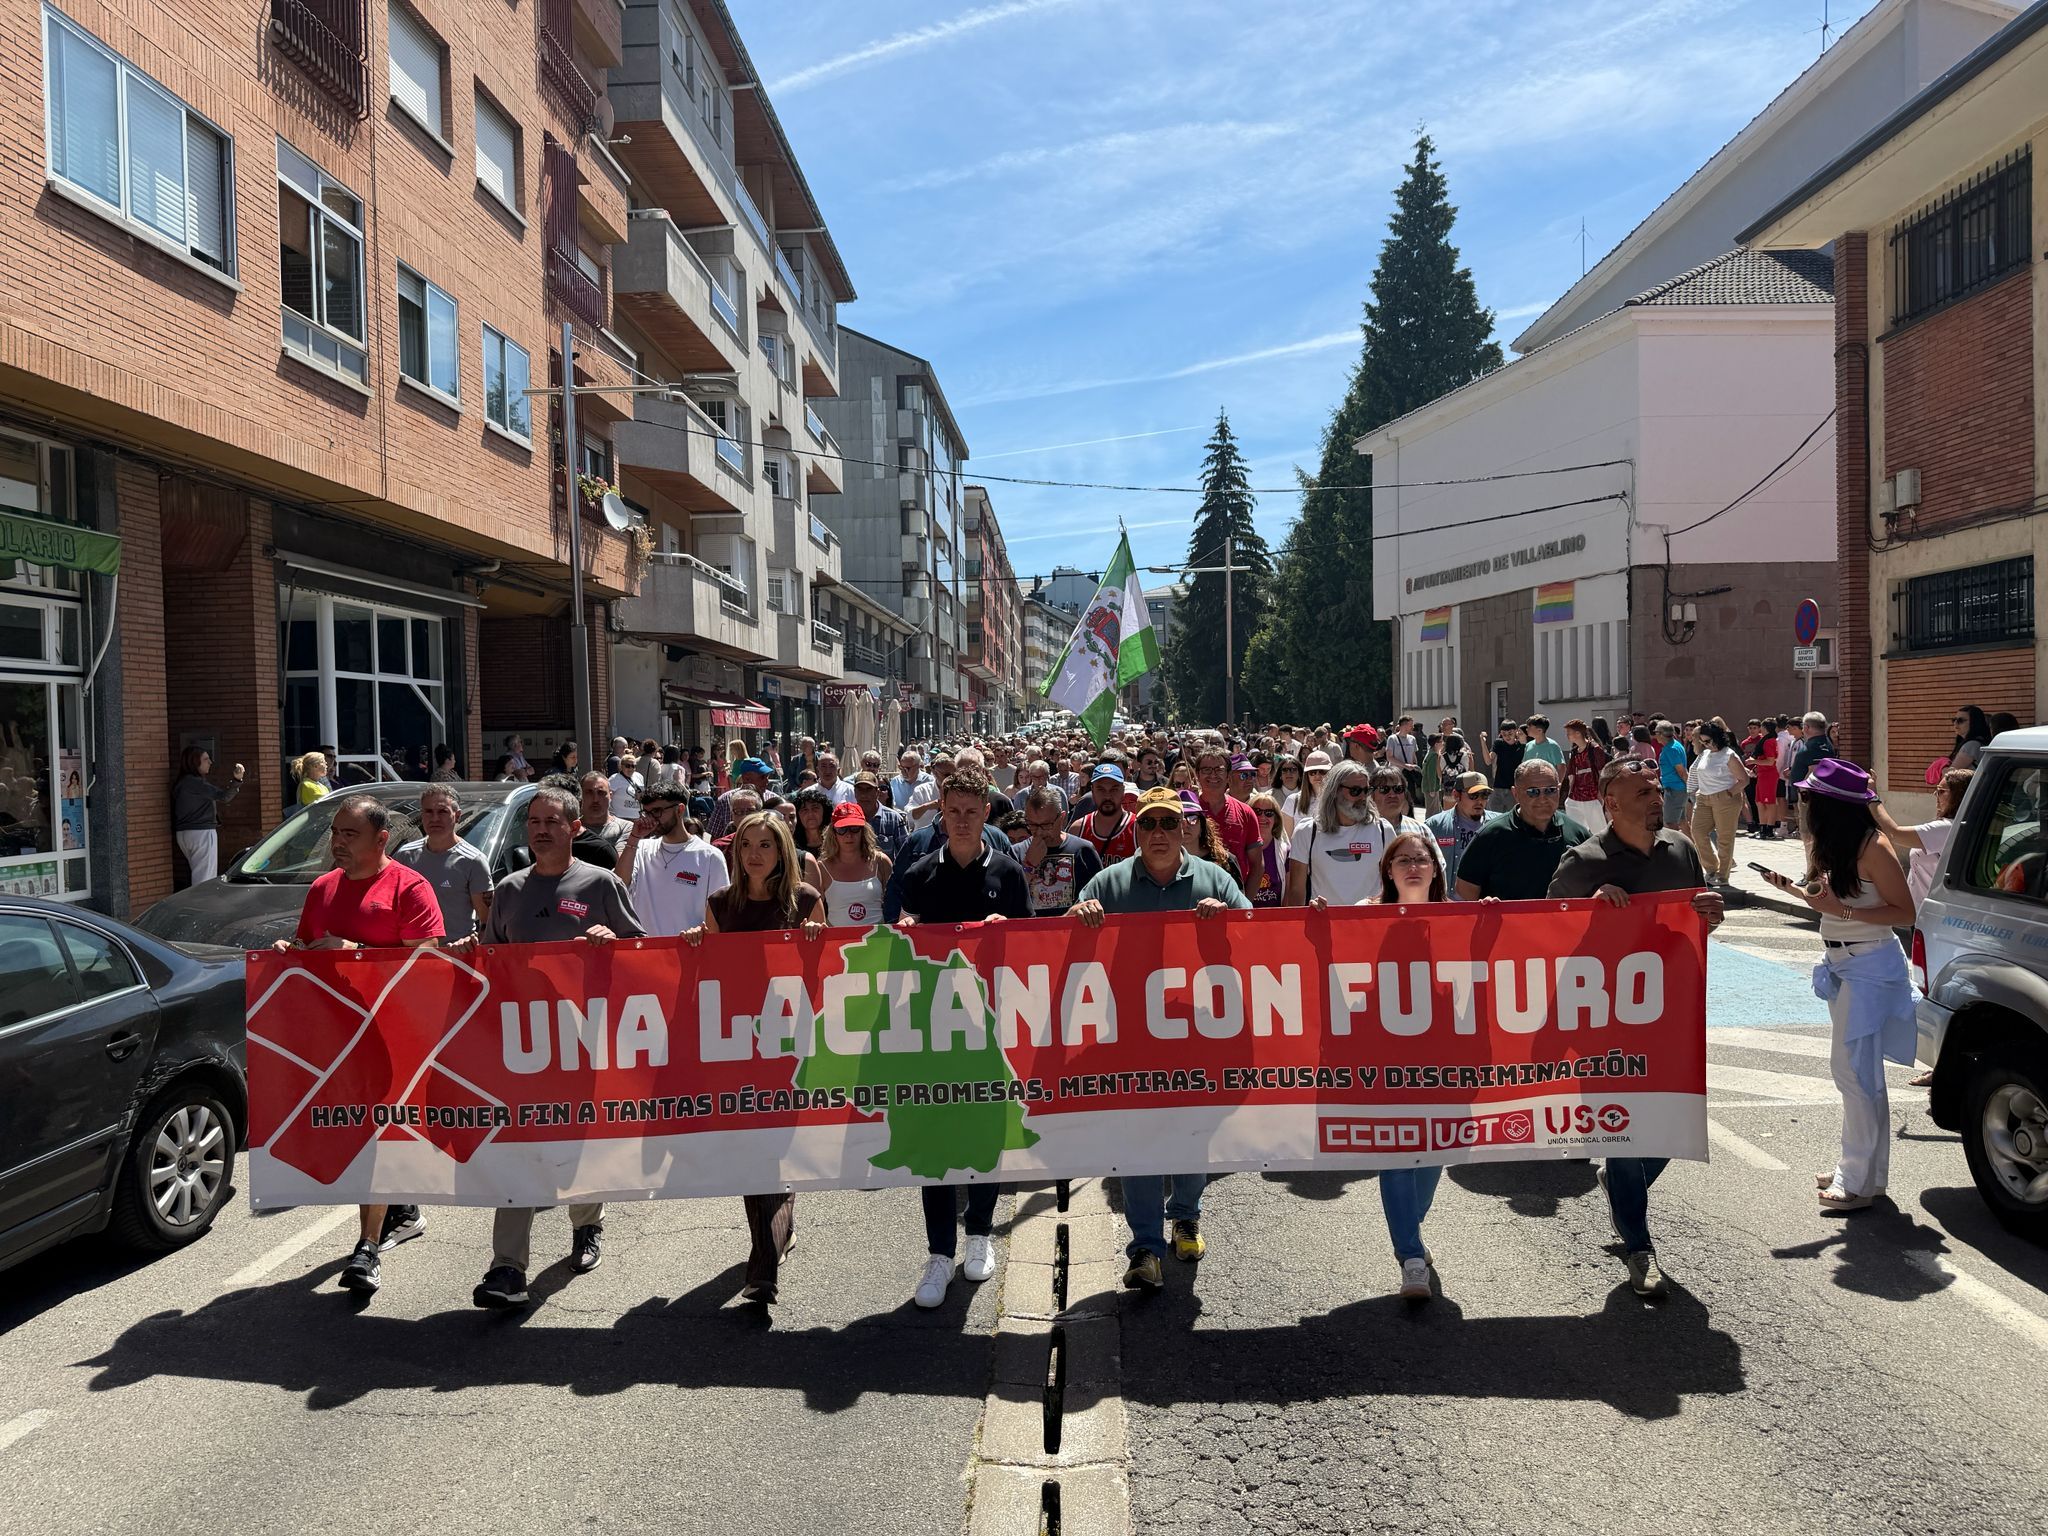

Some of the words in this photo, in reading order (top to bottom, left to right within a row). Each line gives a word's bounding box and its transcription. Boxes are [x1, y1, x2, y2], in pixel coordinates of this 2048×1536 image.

[1413, 559, 1491, 592] AYUNTAMIENTO
[1493, 554, 1510, 572] DE
[1511, 534, 1586, 568] VILLABLINO
[560, 900, 588, 912] CCOO
[1942, 915, 2015, 940] INTERCOOLER
[501, 994, 669, 1074] UNA
[699, 961, 1118, 1063] LACIANA
[1145, 963, 1304, 1040] CON
[1328, 951, 1665, 1037] FUTURO
[311, 1105, 367, 1129] HAY
[372, 1104, 422, 1127] QUE
[425, 1105, 512, 1129] PONER
[518, 1101, 571, 1127] FIN
[576, 1101, 597, 1124] A
[602, 1092, 713, 1123] TANTAS
[719, 1085, 846, 1115] DÉCADAS
[853, 1084, 889, 1107] DE
[895, 1078, 1054, 1108] PROMESAS,
[1059, 1069, 1217, 1099] MENTIRAS,
[1222, 1066, 1353, 1091] EXCUSAS
[1357, 1065, 1377, 1089] Y
[1385, 1048, 1648, 1089] DISCRIMINACIÓN
[1325, 1124, 1420, 1146] CCOO
[1434, 1117, 1500, 1147] UGT
[1545, 1104, 1631, 1135] USO
[1547, 1137, 1568, 1145] UNIÓN
